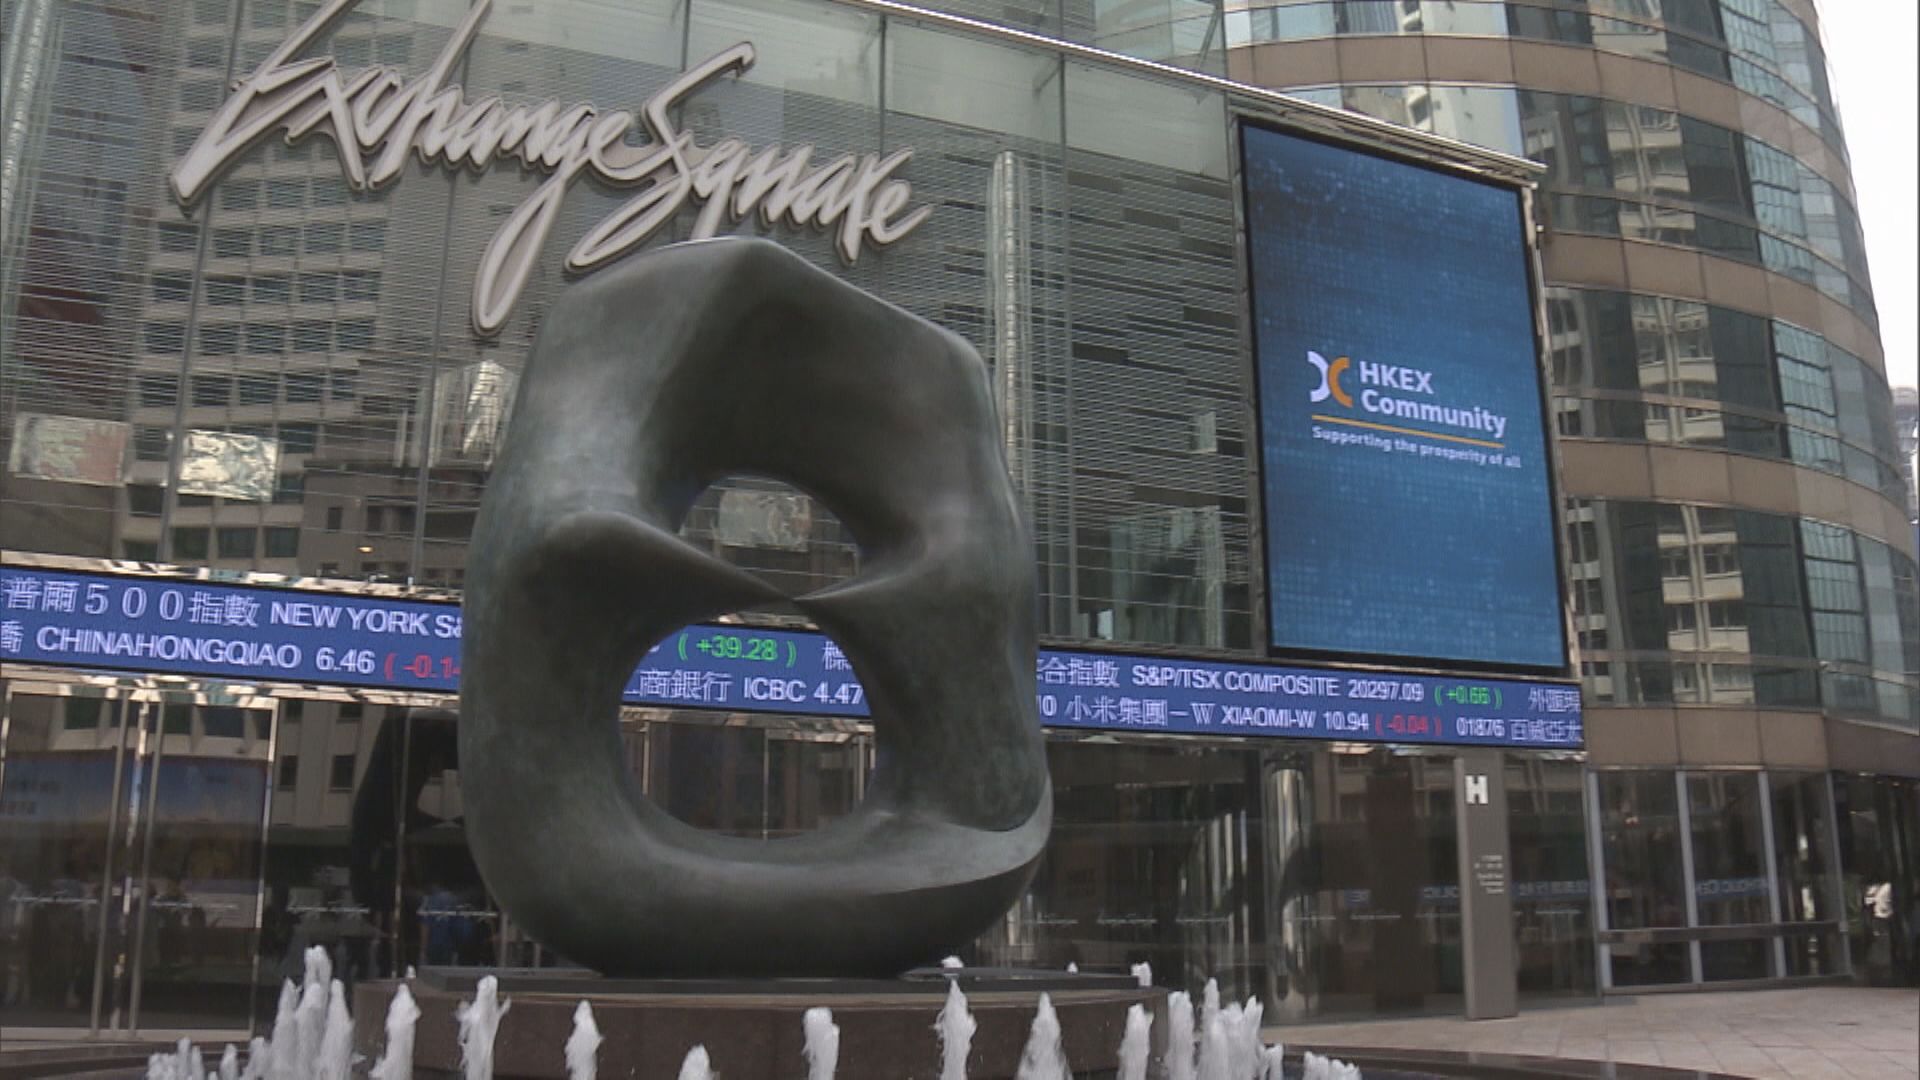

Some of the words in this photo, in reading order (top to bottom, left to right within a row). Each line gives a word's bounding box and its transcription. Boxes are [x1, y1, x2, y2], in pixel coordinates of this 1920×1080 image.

[167, 0, 660, 335] Exchange
[565, 40, 934, 274] Square
[1359, 360, 1434, 394] HKEX
[1361, 388, 1507, 438] Community
[1311, 425, 1393, 452] Supporting
[1394, 438, 1417, 453] the
[1419, 443, 1487, 466] prosperity
[0, 576, 259, 628] 普爾500指數
[270, 601, 344, 630] NEW
[346, 606, 431, 637] YORK
[36, 625, 302, 669] CHINAHONGQIAO
[315, 646, 376, 674] 6.46
[743, 676, 807, 702] ICBC
[813, 681, 864, 706] 4.47
[1131, 664, 1222, 691] S&P/TSX
[1223, 671, 1341, 698] COMPOSITE
[1221, 703, 1317, 730] XIAOMI-W
[1322, 710, 1370, 732] 10.94
[1455, 716, 1506, 738] 01876
